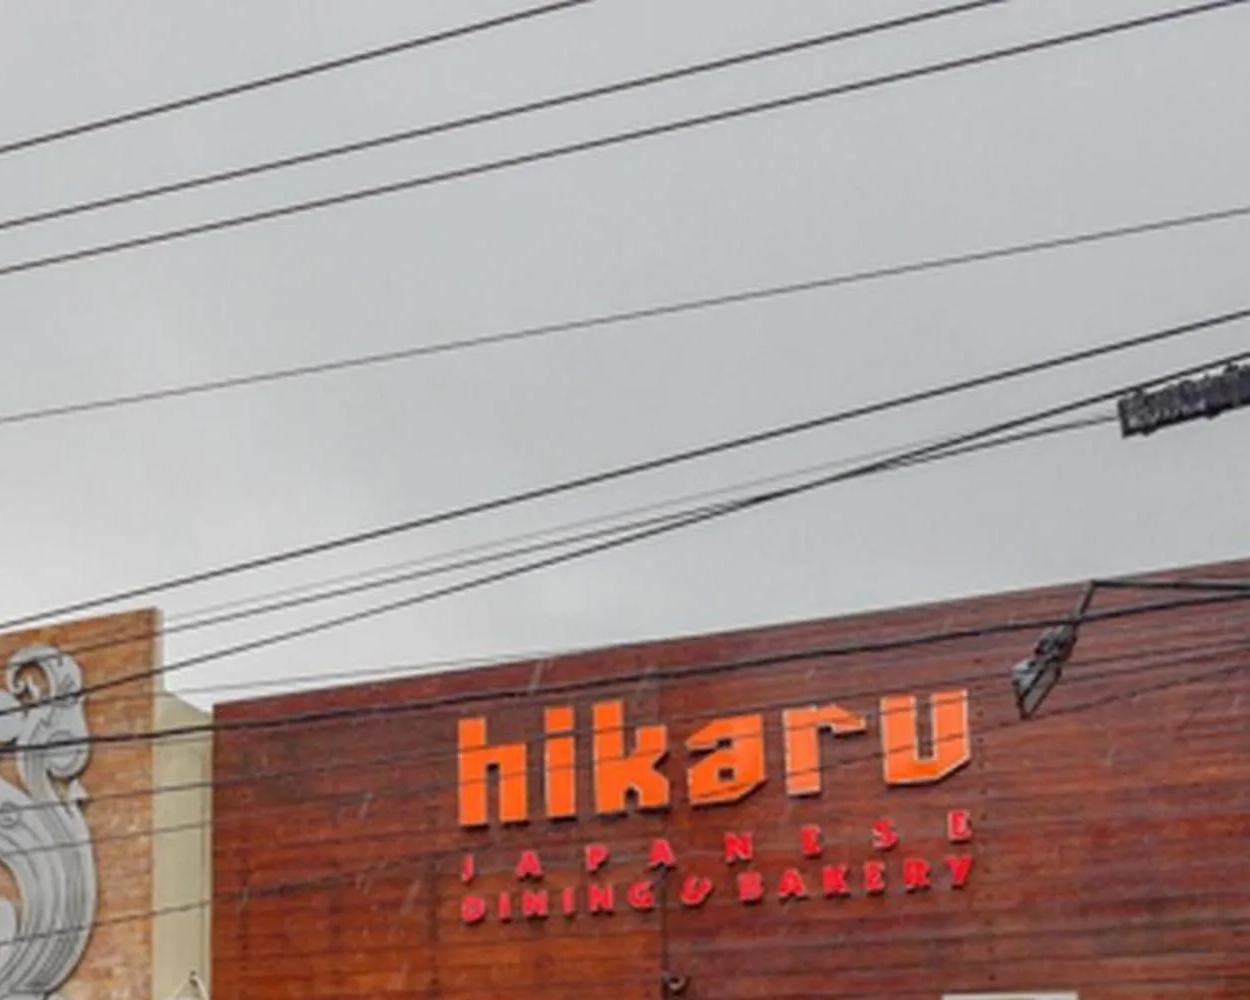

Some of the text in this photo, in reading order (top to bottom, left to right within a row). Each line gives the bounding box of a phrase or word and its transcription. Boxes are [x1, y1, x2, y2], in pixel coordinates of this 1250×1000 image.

[457, 689, 972, 827] hikaru
[461, 808, 972, 883] JAPANESE
[461, 880, 655, 923] DINING
[737, 853, 972, 901] BAKERY
